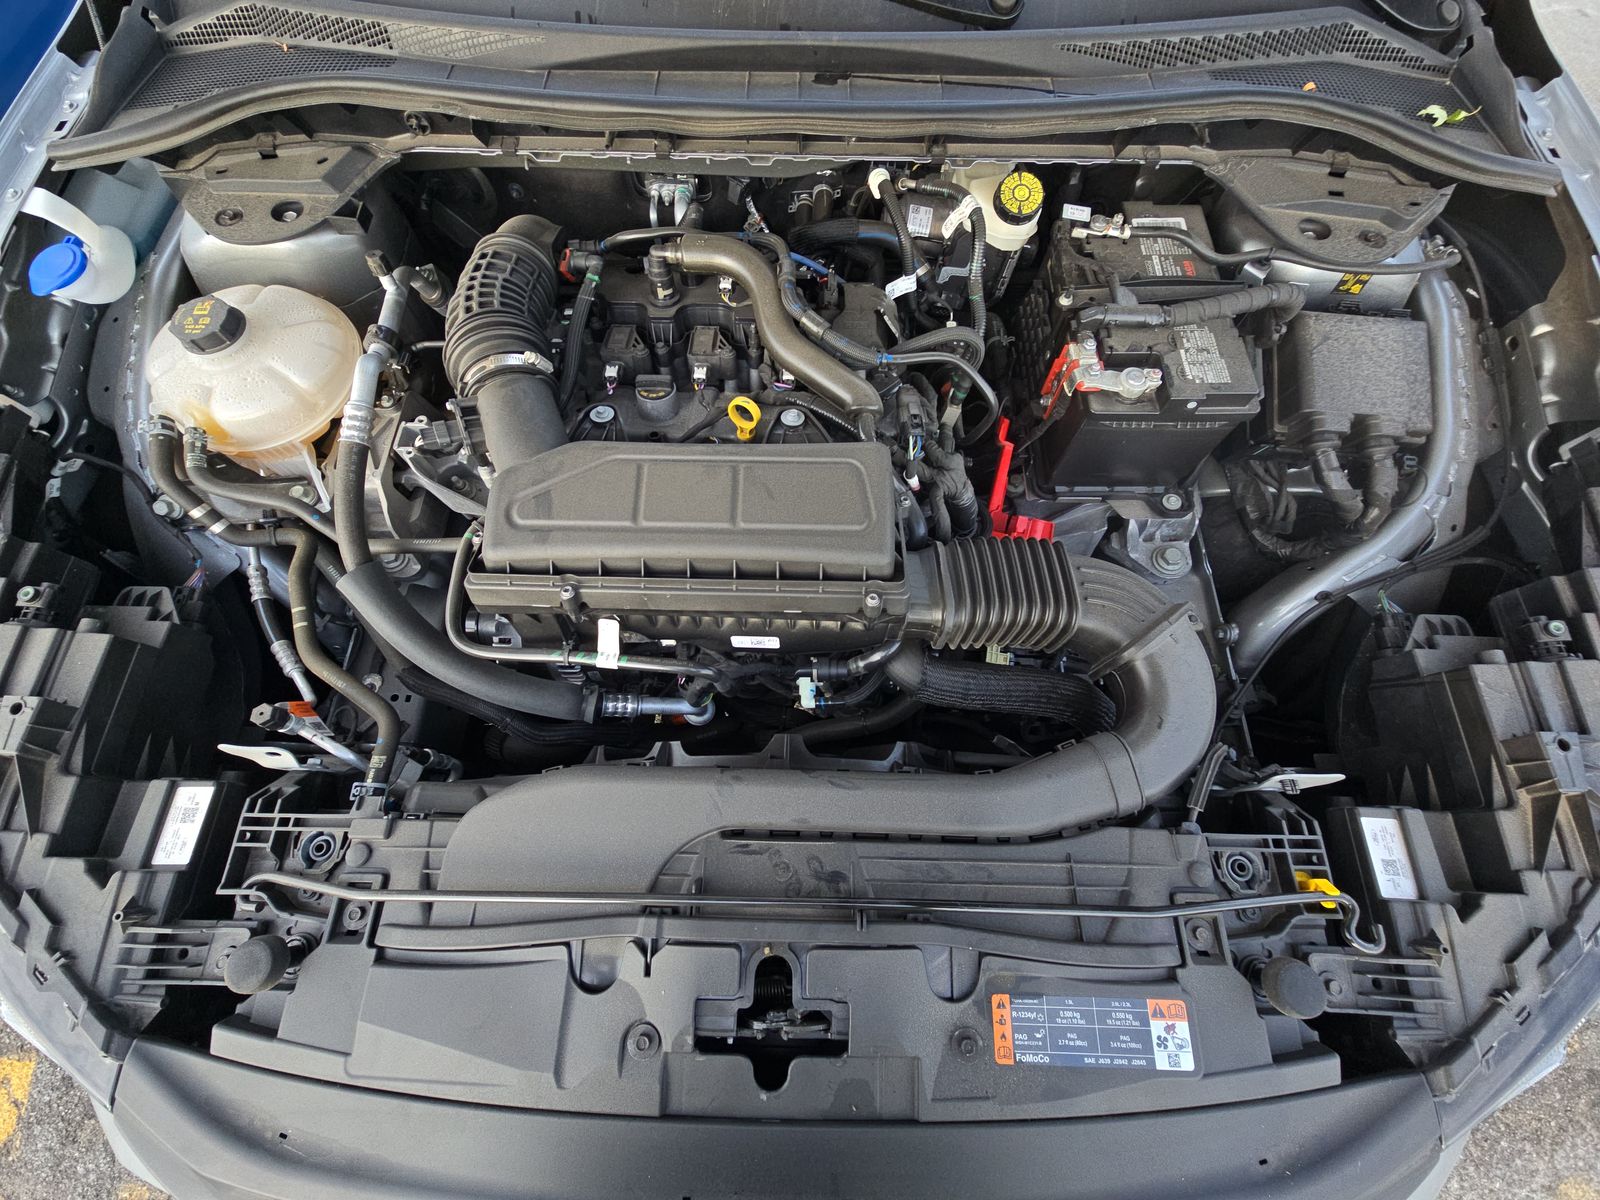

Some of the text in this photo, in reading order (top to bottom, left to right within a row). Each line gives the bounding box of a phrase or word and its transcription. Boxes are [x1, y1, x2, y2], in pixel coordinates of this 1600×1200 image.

[1012, 1011, 1037, 1019] R-1234yf
[1073, 1011, 1080, 1019] kg
[1016, 1053, 1050, 1063] FoMoCo
